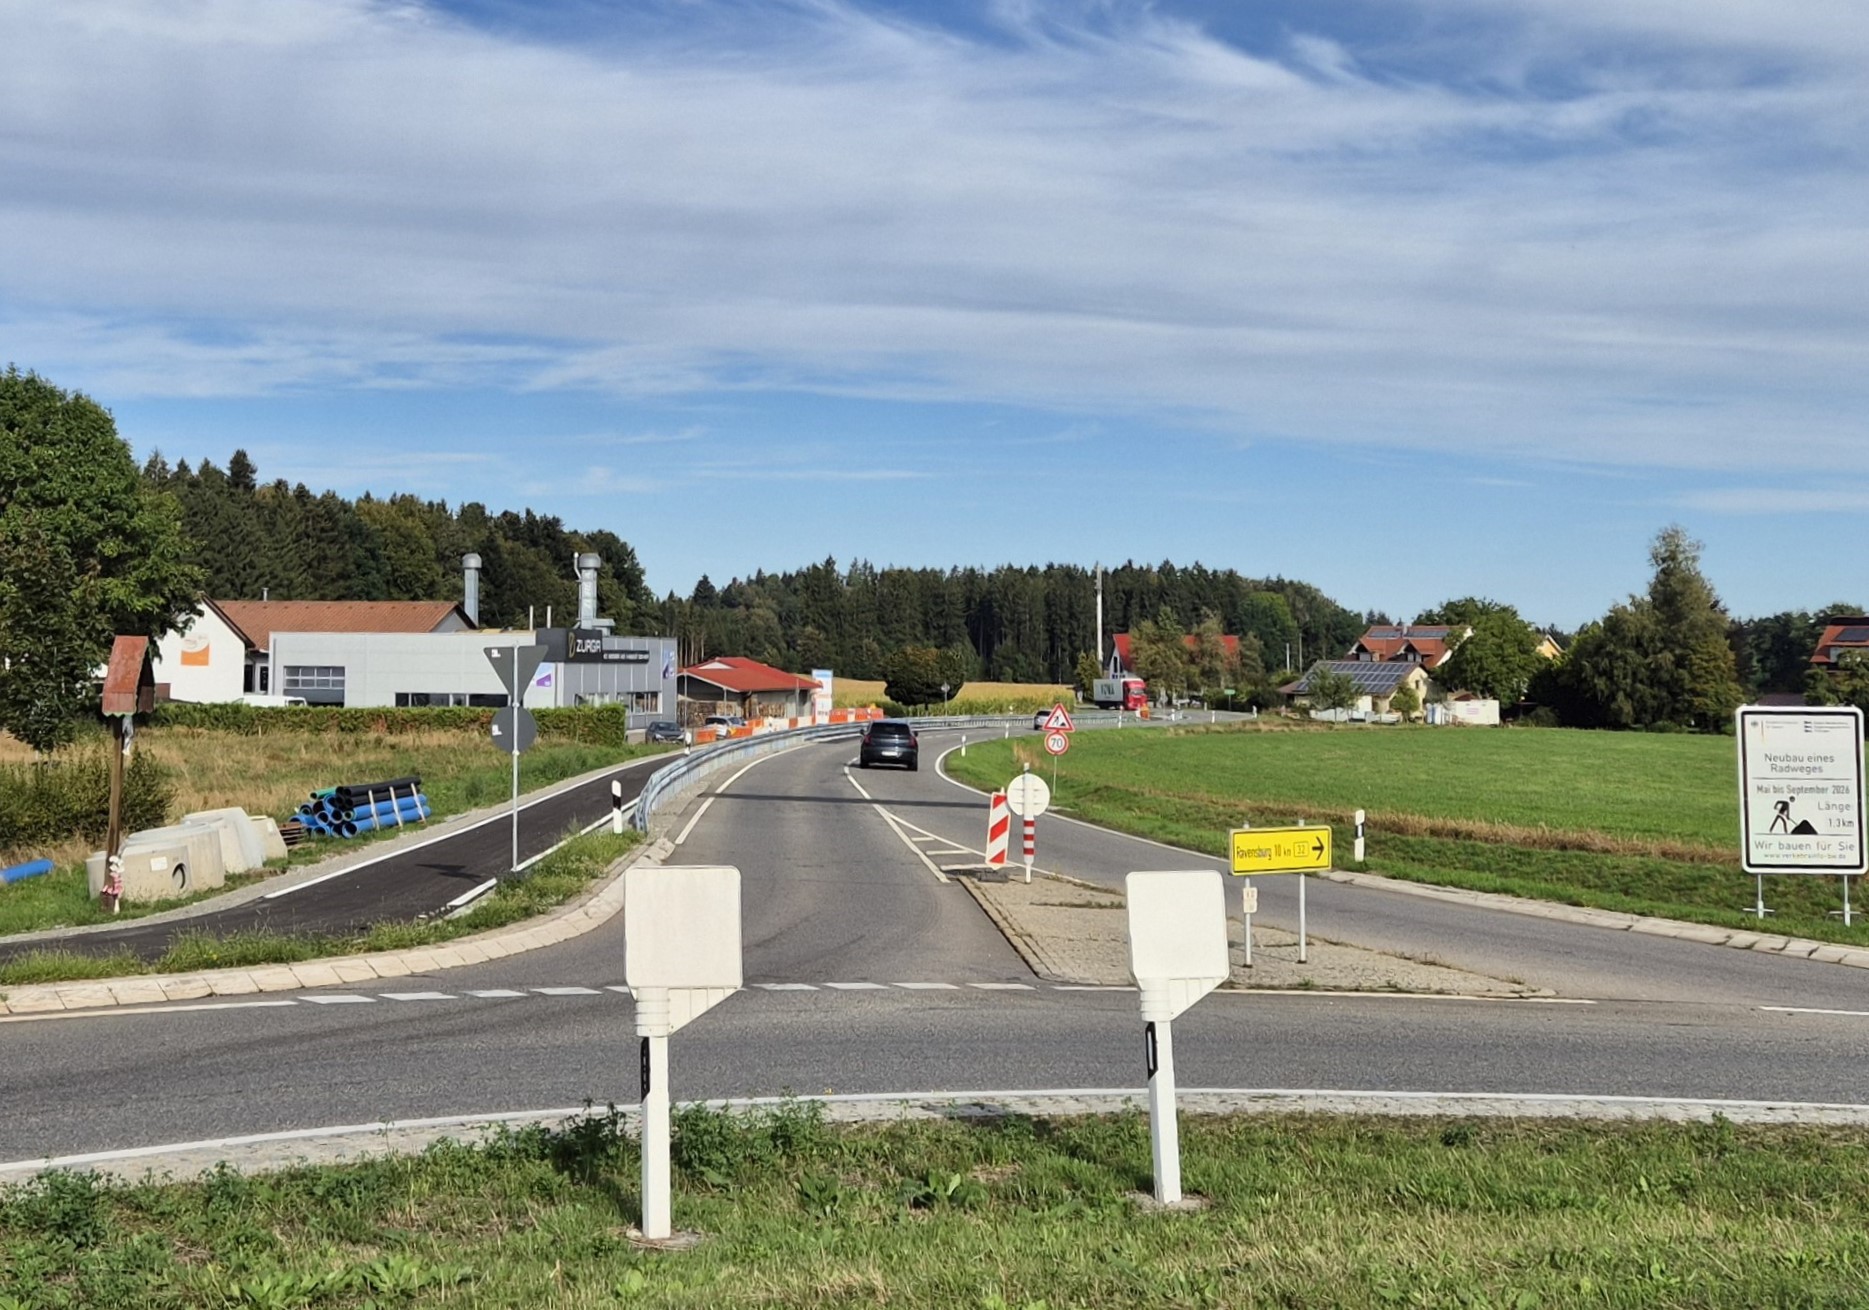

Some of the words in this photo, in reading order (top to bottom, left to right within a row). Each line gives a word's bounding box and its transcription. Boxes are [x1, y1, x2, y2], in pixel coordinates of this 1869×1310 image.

[1050, 737, 1063, 748] 70
[1764, 753, 1804, 763] Neubau
[1807, 754, 1835, 763] eines
[1770, 763, 1824, 775] Radweges
[1756, 785, 1771, 794] Mai
[1773, 785, 1785, 794] bis
[1786, 785, 1829, 796] September
[1832, 785, 1850, 794] 2026
[1818, 801, 1851, 812] Länge
[1754, 841, 1773, 850] Wir
[1778, 841, 1811, 851] bauen
[1817, 841, 1832, 851] für
[1838, 841, 1855, 851] Sie
[1236, 845, 1272, 861] Ravensburg
[1274, 843, 1282, 857] 10
